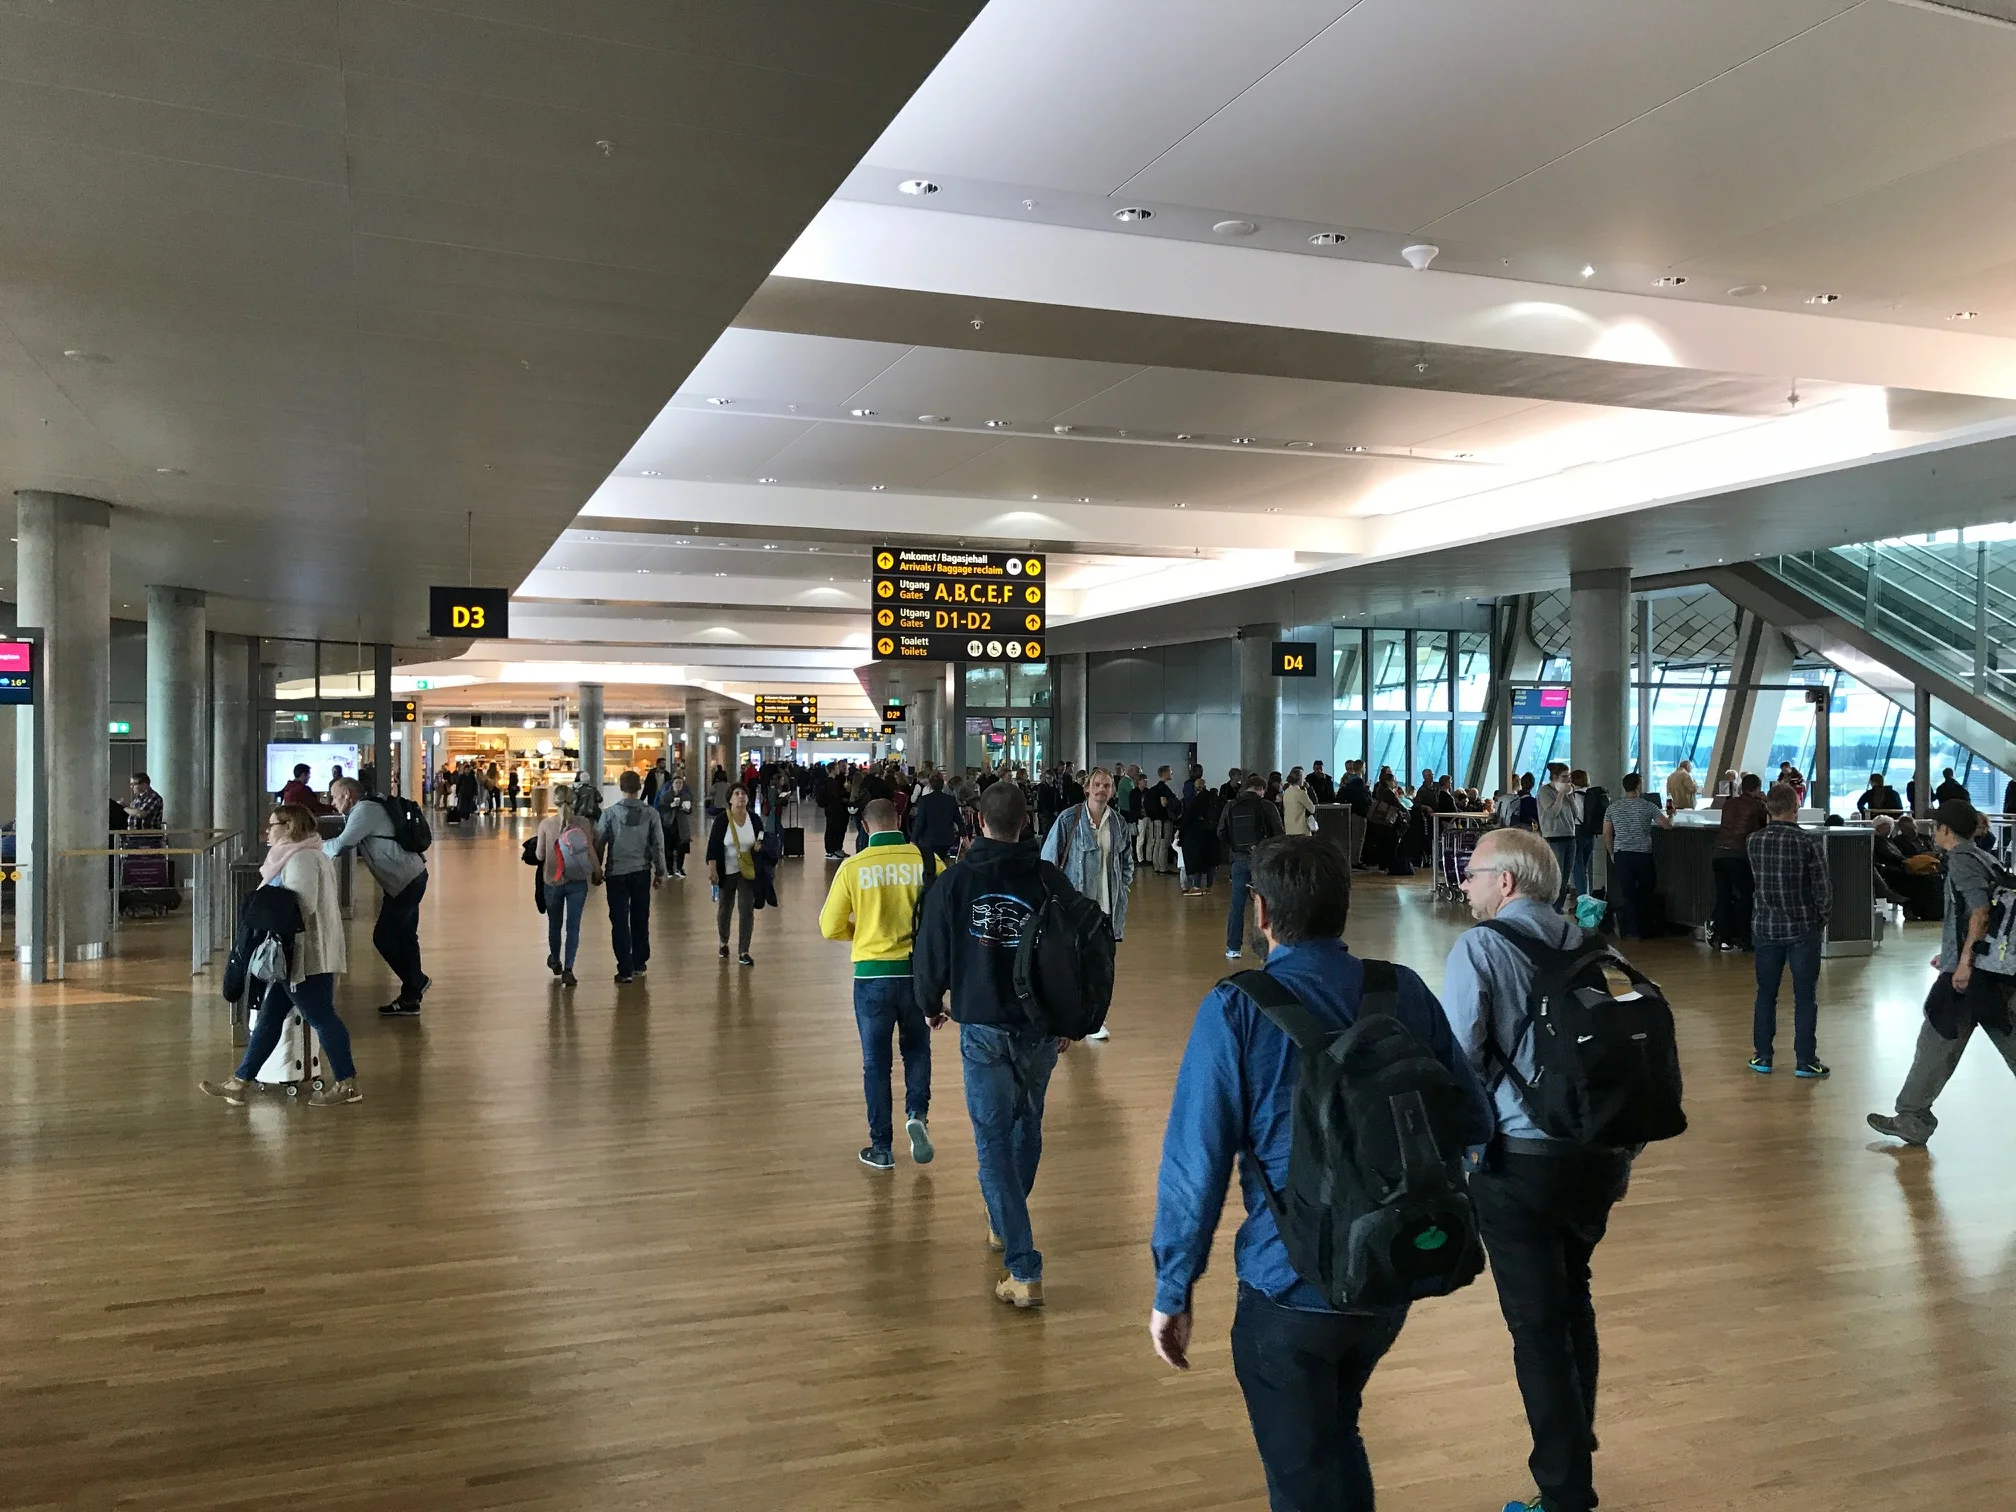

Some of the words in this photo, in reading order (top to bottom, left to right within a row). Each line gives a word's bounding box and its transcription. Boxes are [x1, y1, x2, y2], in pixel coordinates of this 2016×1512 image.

[900, 551, 937, 562] Ankomst
[942, 553, 988, 565] Bagasjehall
[900, 562, 932, 572] Arrivals
[937, 564, 973, 575] Baggage
[974, 566, 1003, 575] reclaim
[900, 580, 930, 591] Utgang
[900, 590, 924, 600] Gates
[453, 606, 485, 628] D3
[900, 608, 930, 620] Utgang
[936, 611, 991, 630] D1-D2
[900, 619, 924, 628] Gates
[900, 637, 929, 646] Toalett
[900, 647, 927, 656] Toilets
[1284, 655, 1304, 670] D4
